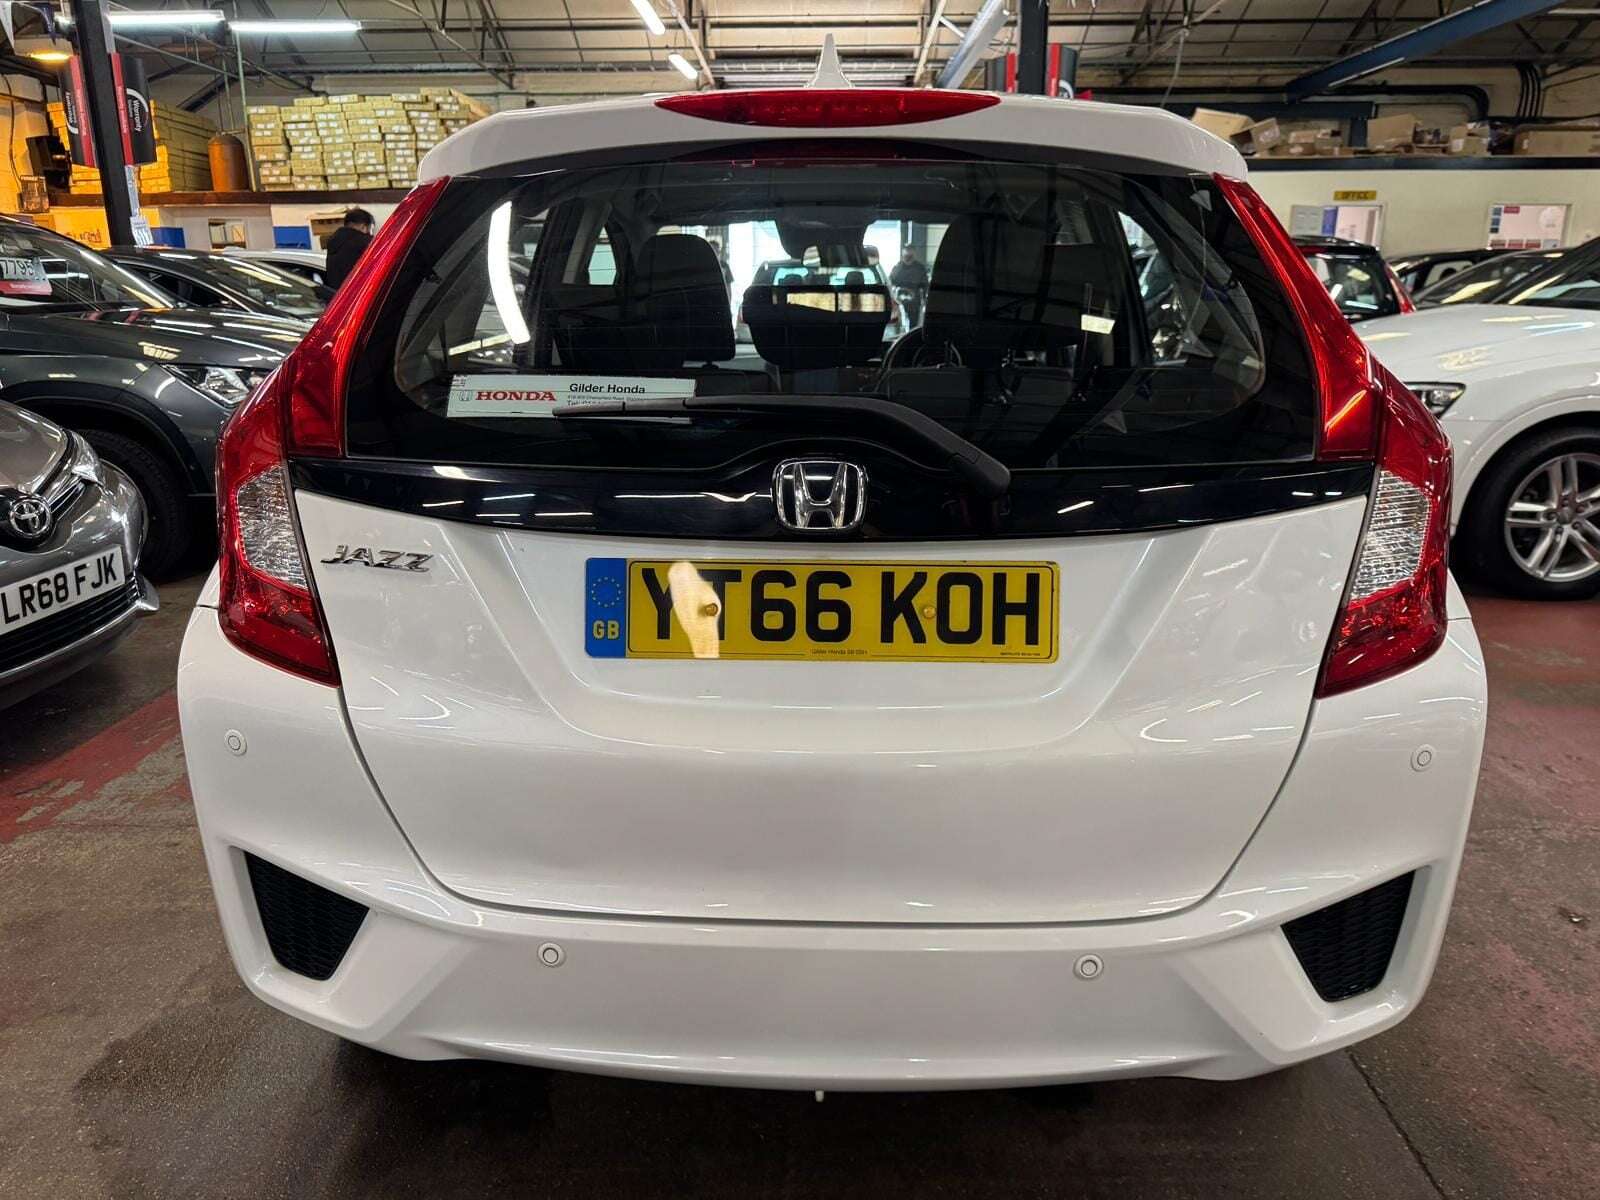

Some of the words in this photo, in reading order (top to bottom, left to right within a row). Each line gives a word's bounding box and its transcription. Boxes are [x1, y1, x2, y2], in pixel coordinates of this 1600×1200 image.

[475, 391, 557, 402] HONDA
[569, 383, 604, 393] Gilder
[607, 383, 646, 394] Honda
[320, 545, 434, 572] JAZZ
[1, 571, 69, 625] LR68
[74, 553, 117, 596] FJK
[641, 567, 852, 643] YT66
[880, 571, 1040, 646] KOH
[592, 620, 620, 640] GB
